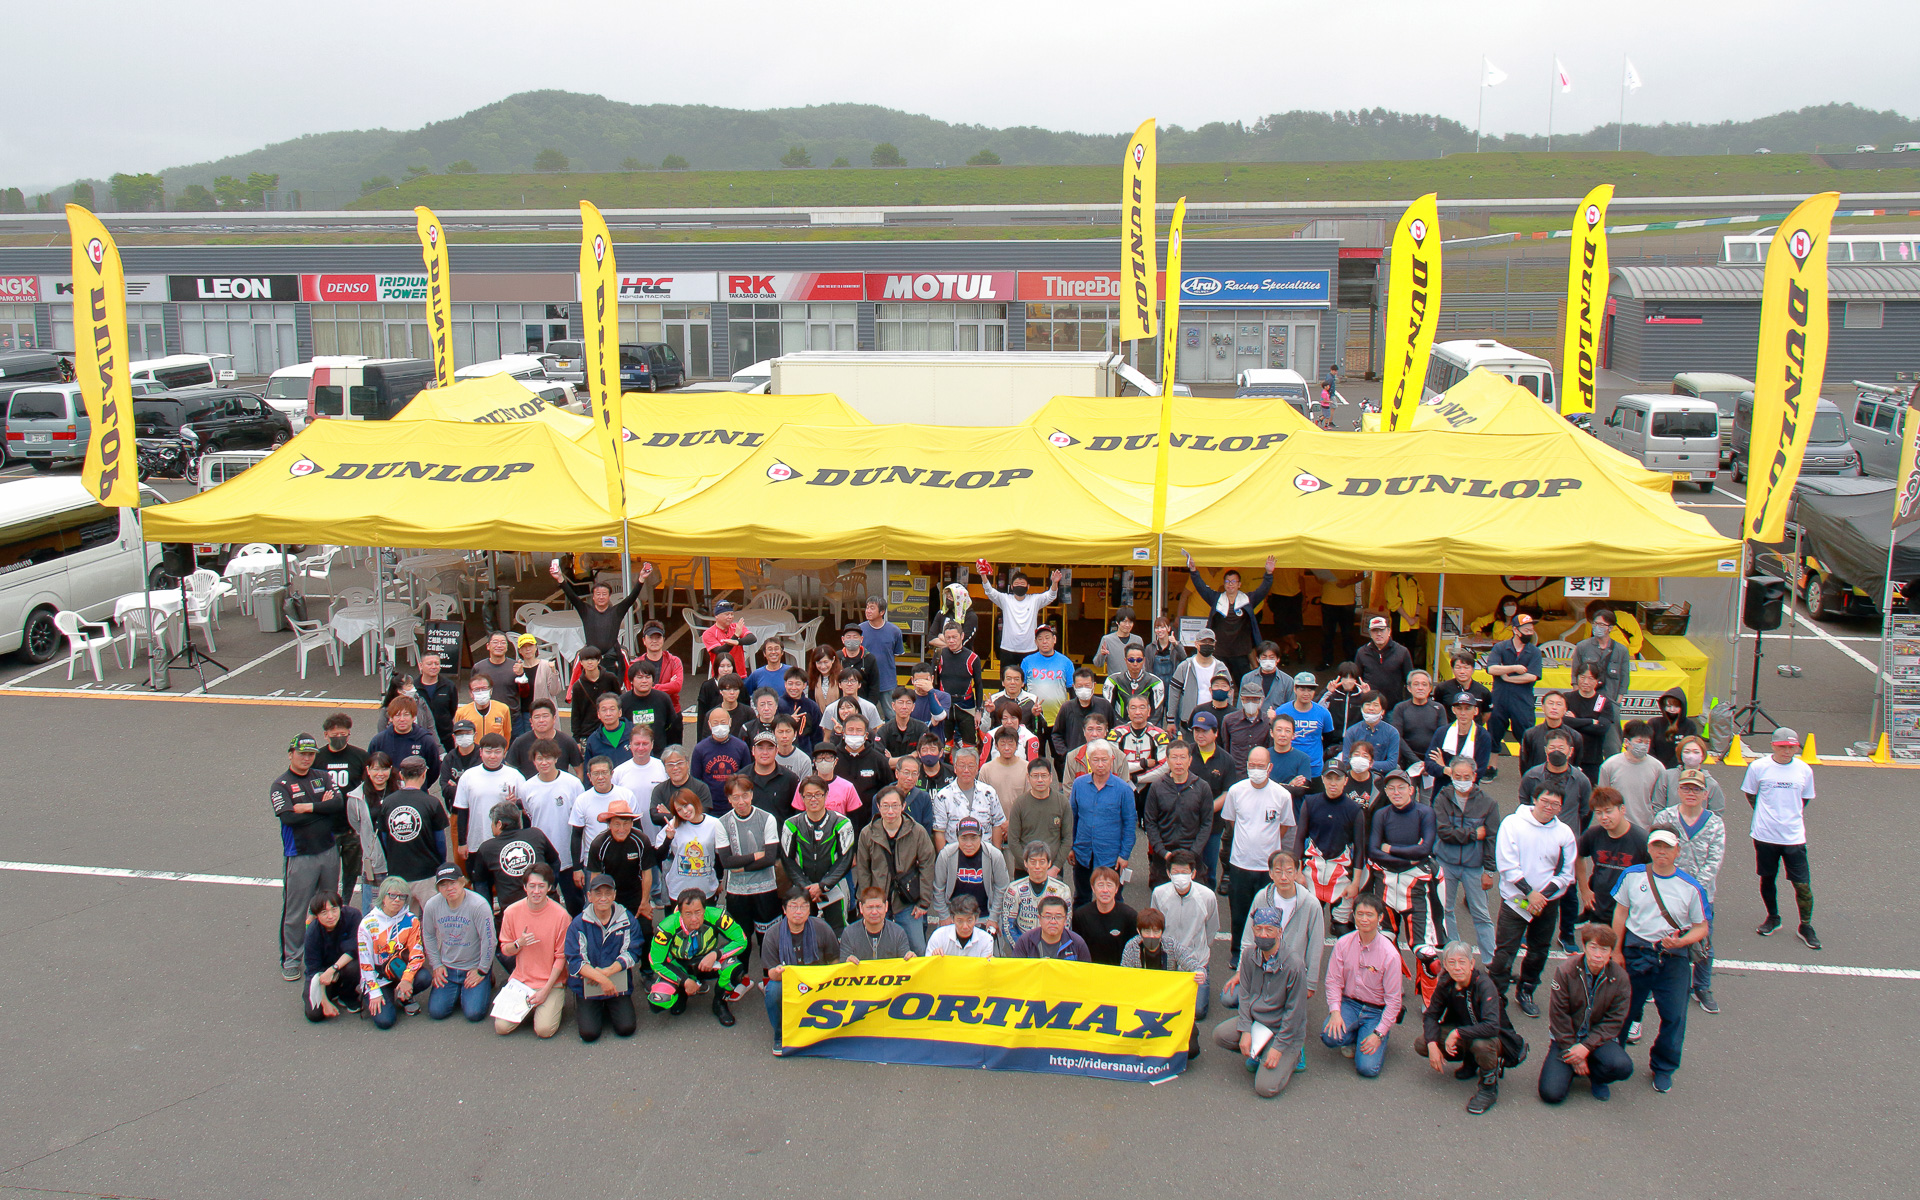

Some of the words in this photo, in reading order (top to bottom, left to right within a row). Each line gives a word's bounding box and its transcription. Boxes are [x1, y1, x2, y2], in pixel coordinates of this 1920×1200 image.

[1130, 174, 1150, 335] DUNLOP
[197, 278, 272, 299] LEON
[326, 282, 370, 294] DENSO
[379, 276, 428, 288] IRIDIUM
[620, 277, 674, 294] HRC
[728, 275, 776, 294] RK
[883, 274, 997, 300] MOTUL
[1042, 276, 1121, 297] ThreeBo
[1185, 278, 1217, 290] Arai
[1224, 280, 1260, 293] Racing
[1261, 278, 1321, 291] Specialities
[382, 288, 427, 299] POWER
[1578, 236, 1597, 409] DUNLOP
[642, 429, 764, 447] DUNL
[324, 461, 535, 483] DUNLOP
[805, 465, 1034, 489] DUNLOP
[1338, 474, 1583, 499] DUNLOP
[1570, 577, 1604, 591] 受付
[815, 974, 912, 993] DUNLOP
[798, 992, 1183, 1040] SPORTMAX
